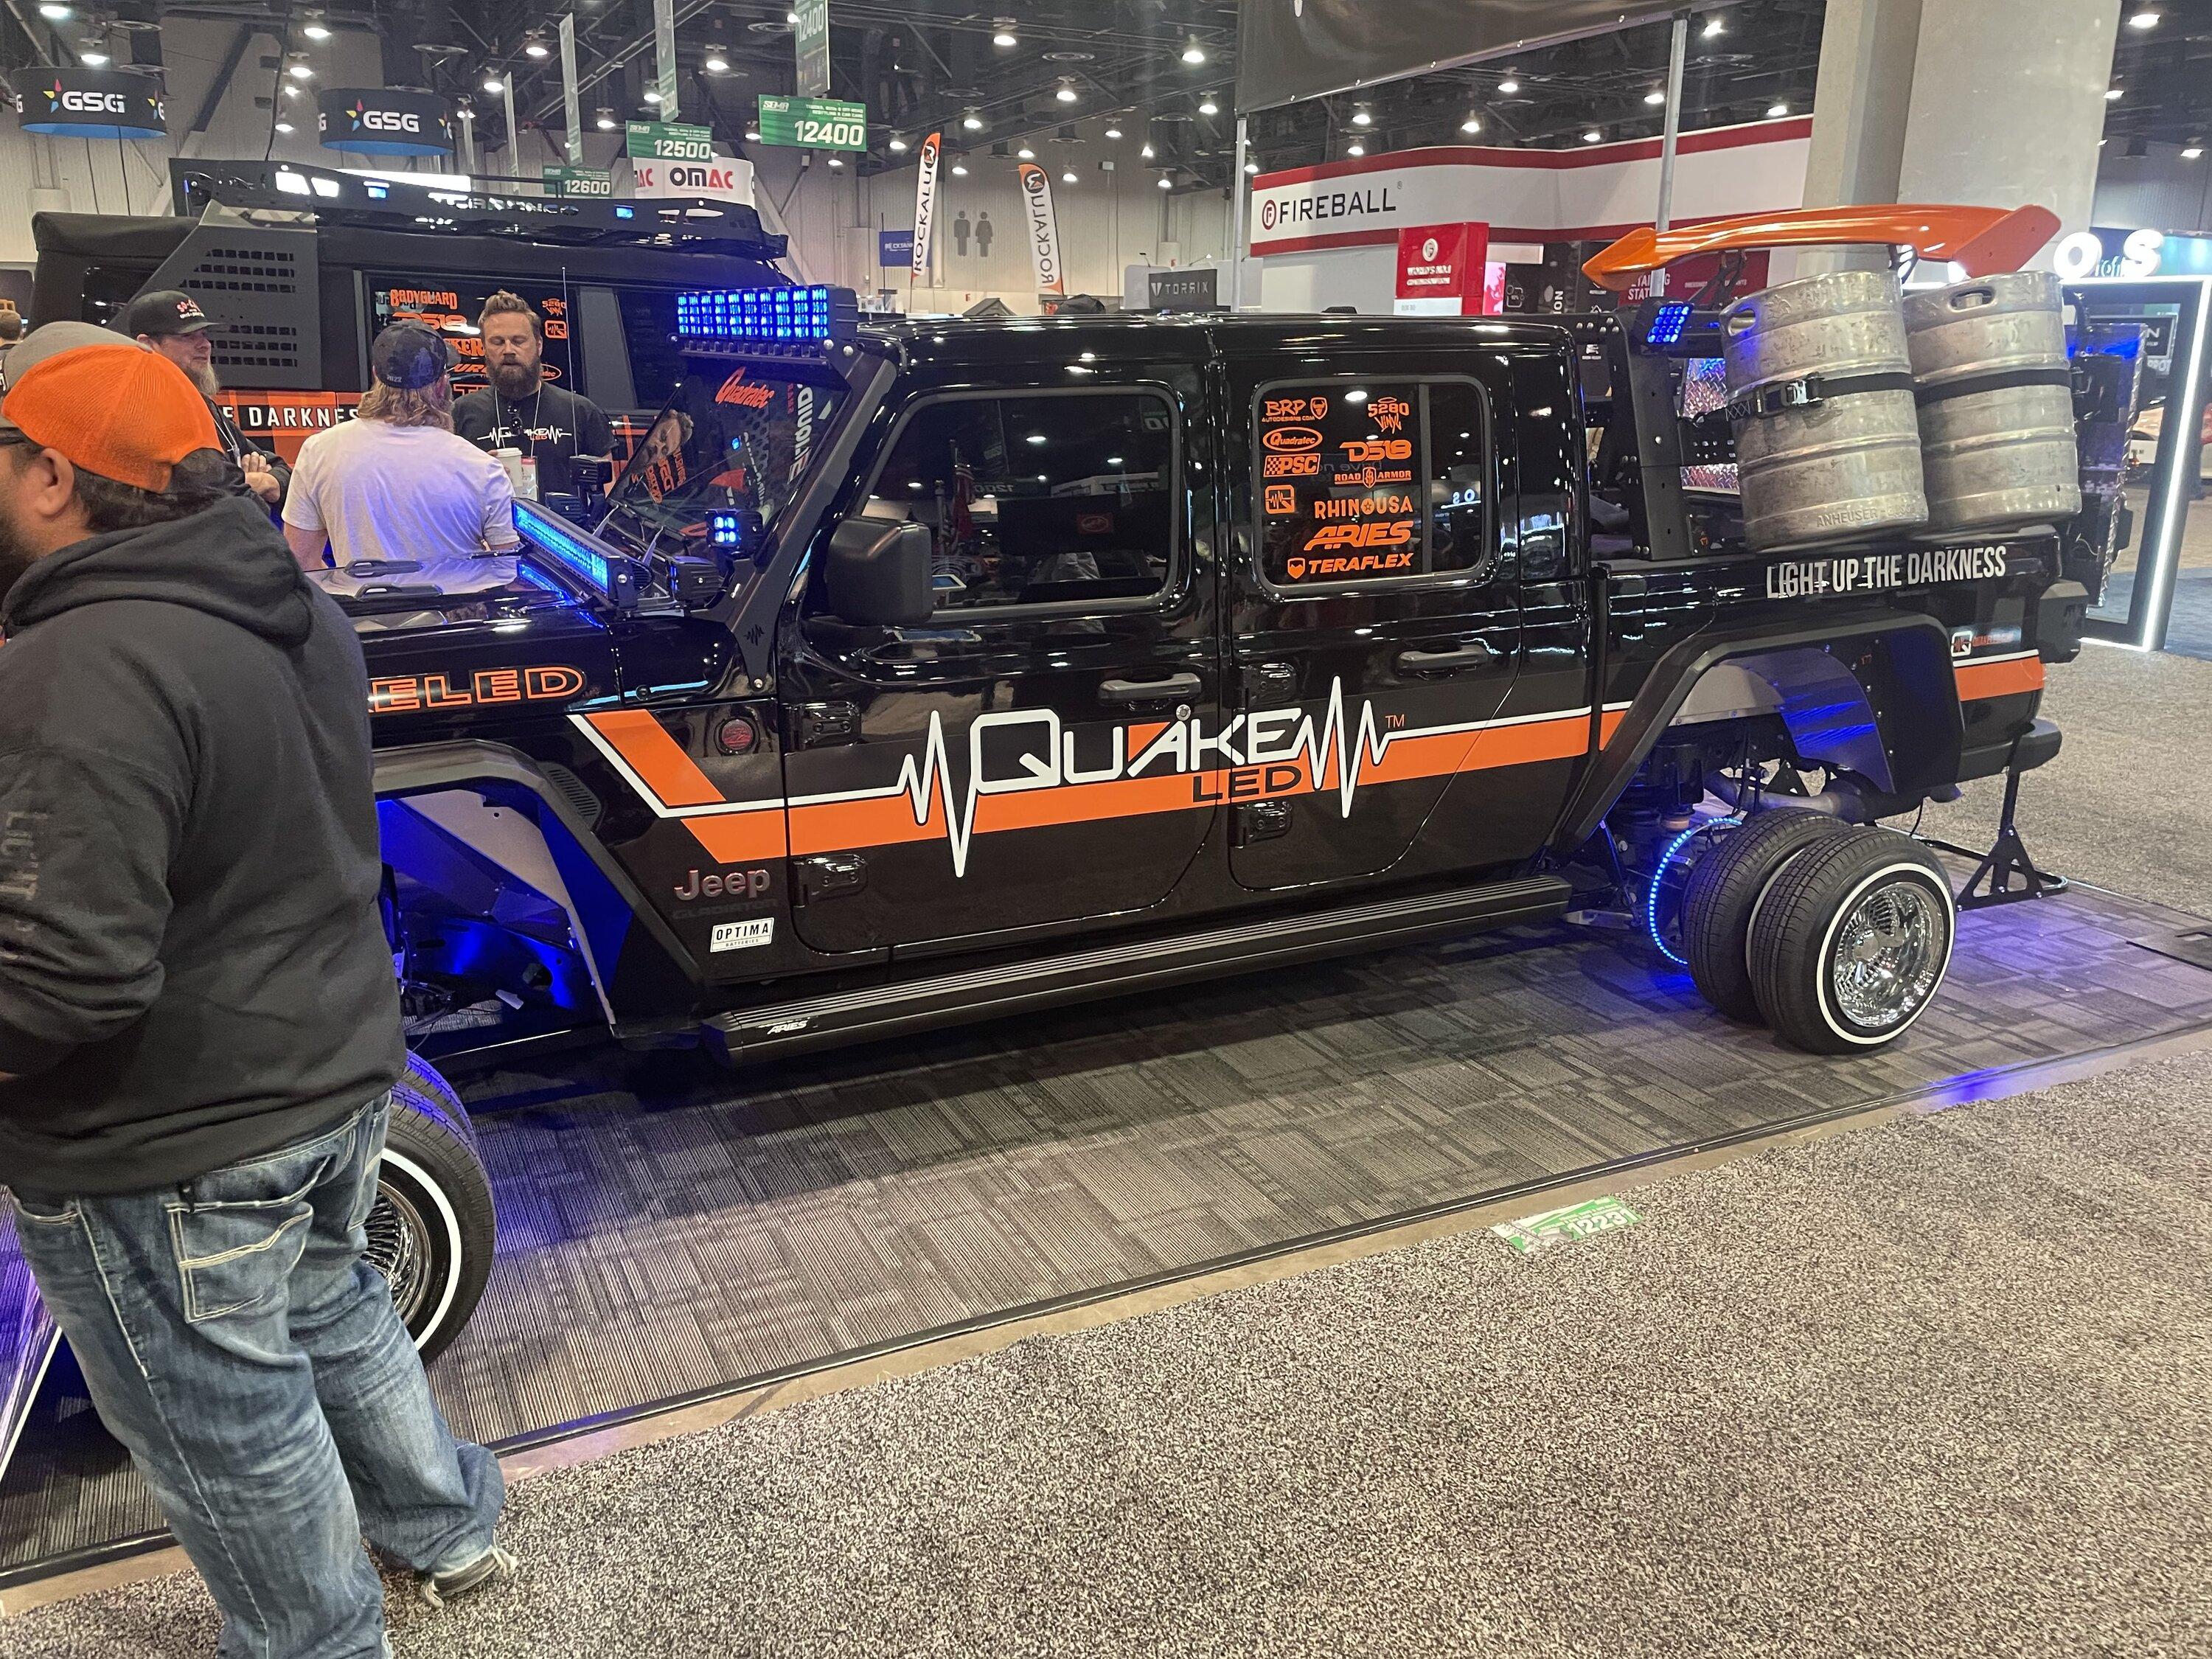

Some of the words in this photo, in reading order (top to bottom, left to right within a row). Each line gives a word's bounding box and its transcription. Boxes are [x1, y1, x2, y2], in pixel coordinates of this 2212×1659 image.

[799, 3, 824, 43] 12400
[61, 91, 125, 114] GSG
[363, 111, 420, 133] GSG
[794, 120, 864, 146] 12400
[654, 139, 712, 159] 12500
[565, 179, 611, 195] 12600
[1279, 187, 1397, 224] FIREBALL
[914, 170, 933, 273] ROCKALU
[390, 288, 458, 310] BODYGUARD
[248, 406, 360, 428] DARKNES
[1264, 399, 1307, 417] BRP
[1368, 402, 1410, 417] 5280
[1270, 432, 1316, 446] Quadratec
[1278, 456, 1318, 476] PSC
[1334, 473, 1361, 482] ROAD
[1377, 470, 1412, 480] ARMOR
[1303, 520, 1414, 551] ARIES
[1308, 552, 1414, 574] TERAFLEX
[1766, 560, 1827, 599] LIGHT
[1832, 558, 1859, 592] UP
[1863, 554, 1902, 588] THE
[1907, 545, 2007, 585] DARKNESS
[1192, 765, 1303, 803] LED
[674, 869, 771, 901] Jeep
[716, 922, 768, 941] OPTIMA
[1567, 1208, 1639, 1236] 12231
